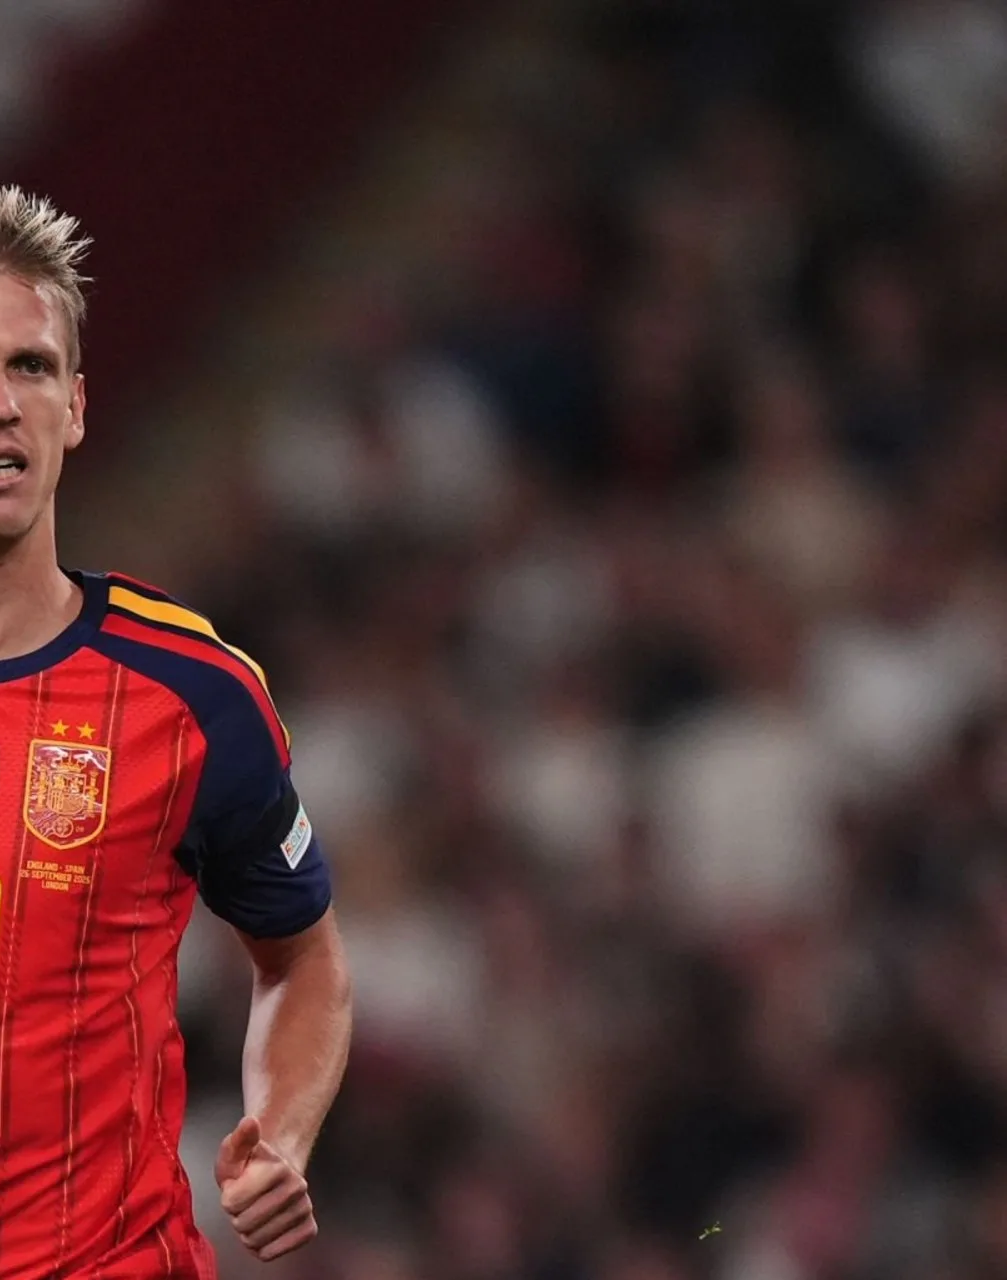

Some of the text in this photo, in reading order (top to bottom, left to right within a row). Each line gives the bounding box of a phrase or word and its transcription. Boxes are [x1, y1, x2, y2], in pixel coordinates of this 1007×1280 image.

[27, 861, 58, 871] ENGLAND
[65, 865, 85, 874] SPAIN
[32, 870, 72, 882] SEPTEMBER
[41, 880, 69, 891] LONDON
